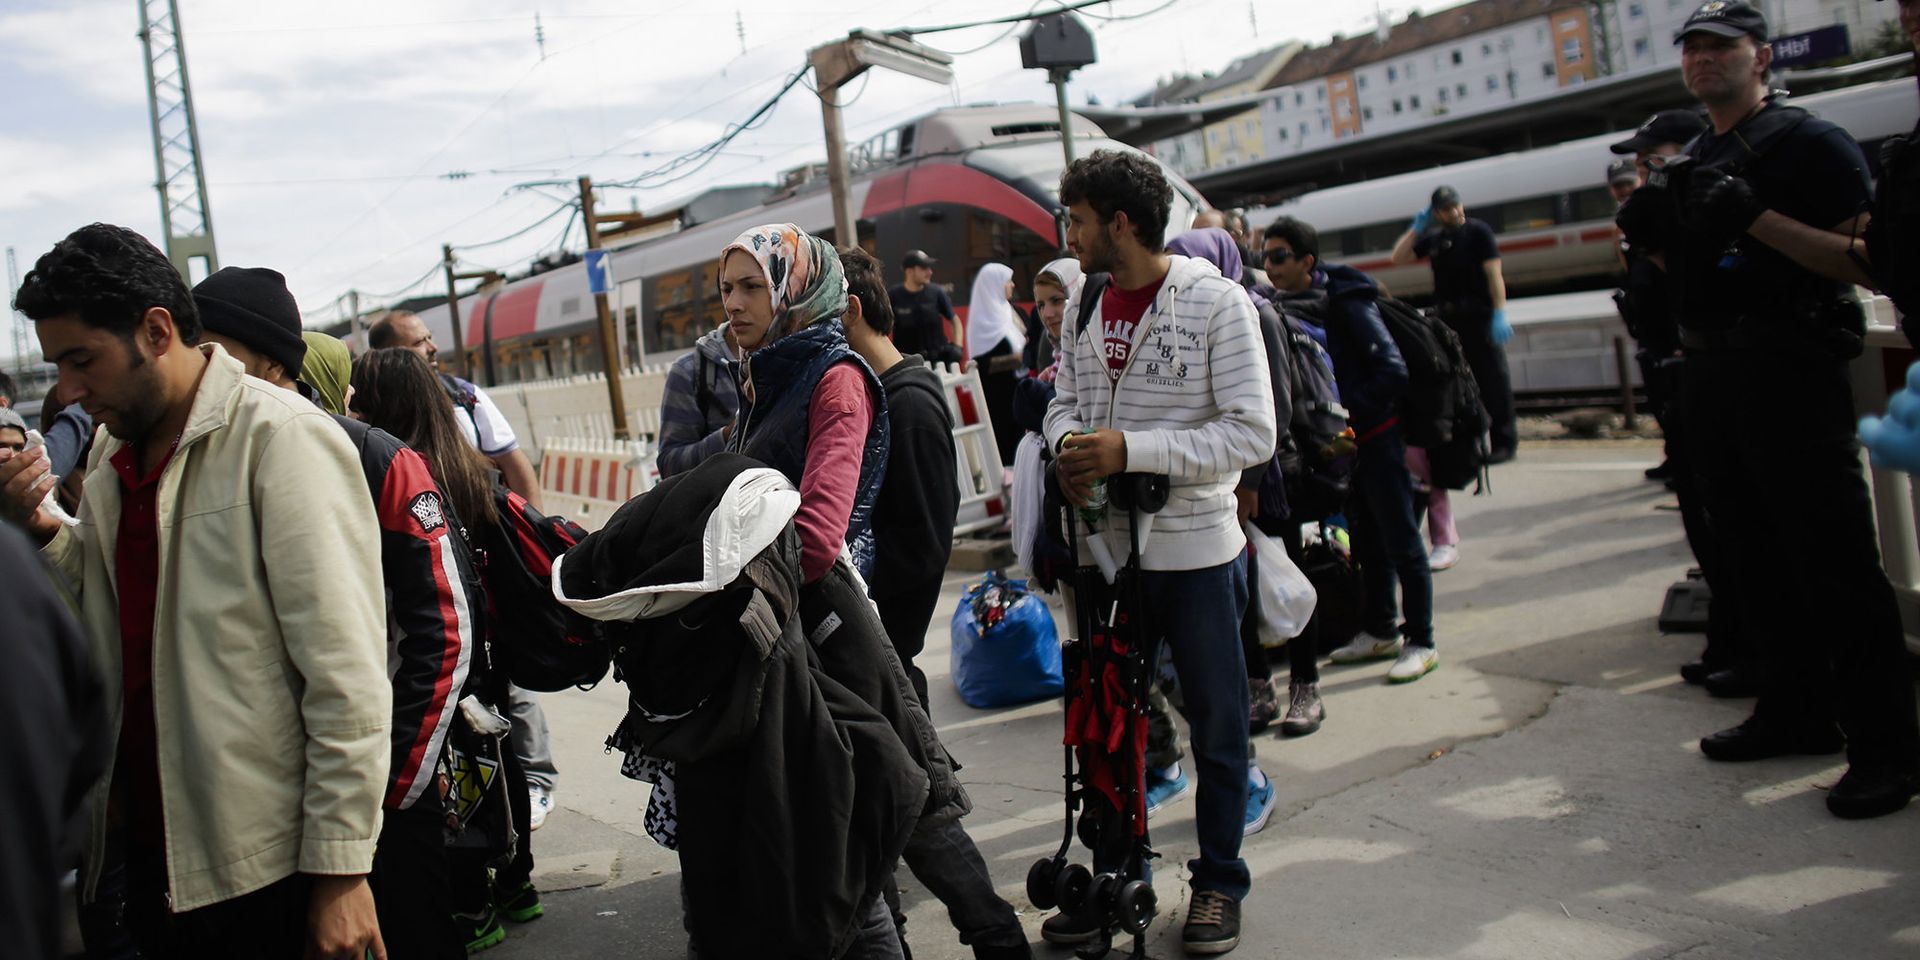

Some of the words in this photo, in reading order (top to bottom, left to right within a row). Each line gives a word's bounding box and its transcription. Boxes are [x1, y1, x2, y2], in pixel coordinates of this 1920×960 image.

[1777, 38, 1810, 59] Hbf
[596, 253, 613, 289] 1
[1147, 324, 1200, 348] ONTANA
[1105, 342, 1126, 360] 35
[1146, 378, 1184, 388] GRIZZLIES
